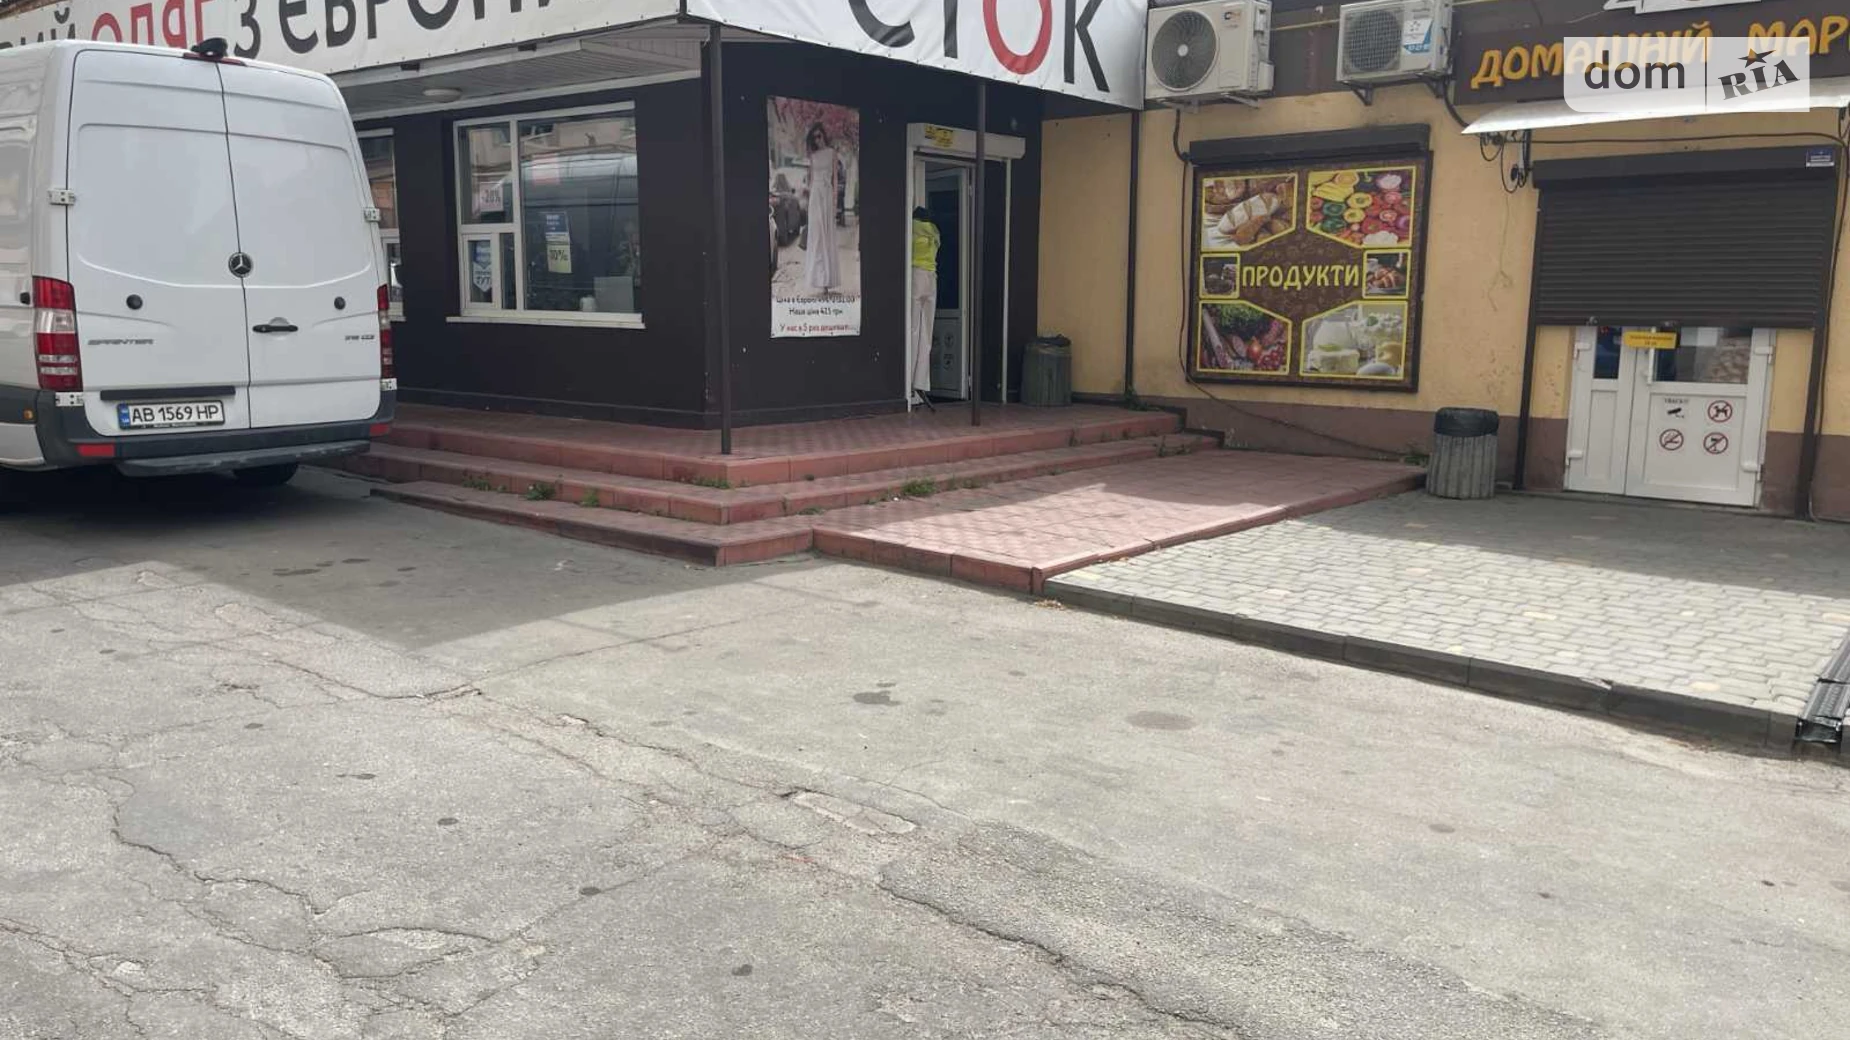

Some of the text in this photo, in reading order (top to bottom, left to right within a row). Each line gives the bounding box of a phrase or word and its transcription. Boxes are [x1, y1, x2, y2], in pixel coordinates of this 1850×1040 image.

[234, 0, 261, 59] З
[1748, 14, 1850, 58] МАР
[1241, 264, 1360, 291] ПРОДУКТИ
[132, 404, 219, 422] AB 1569 HP
